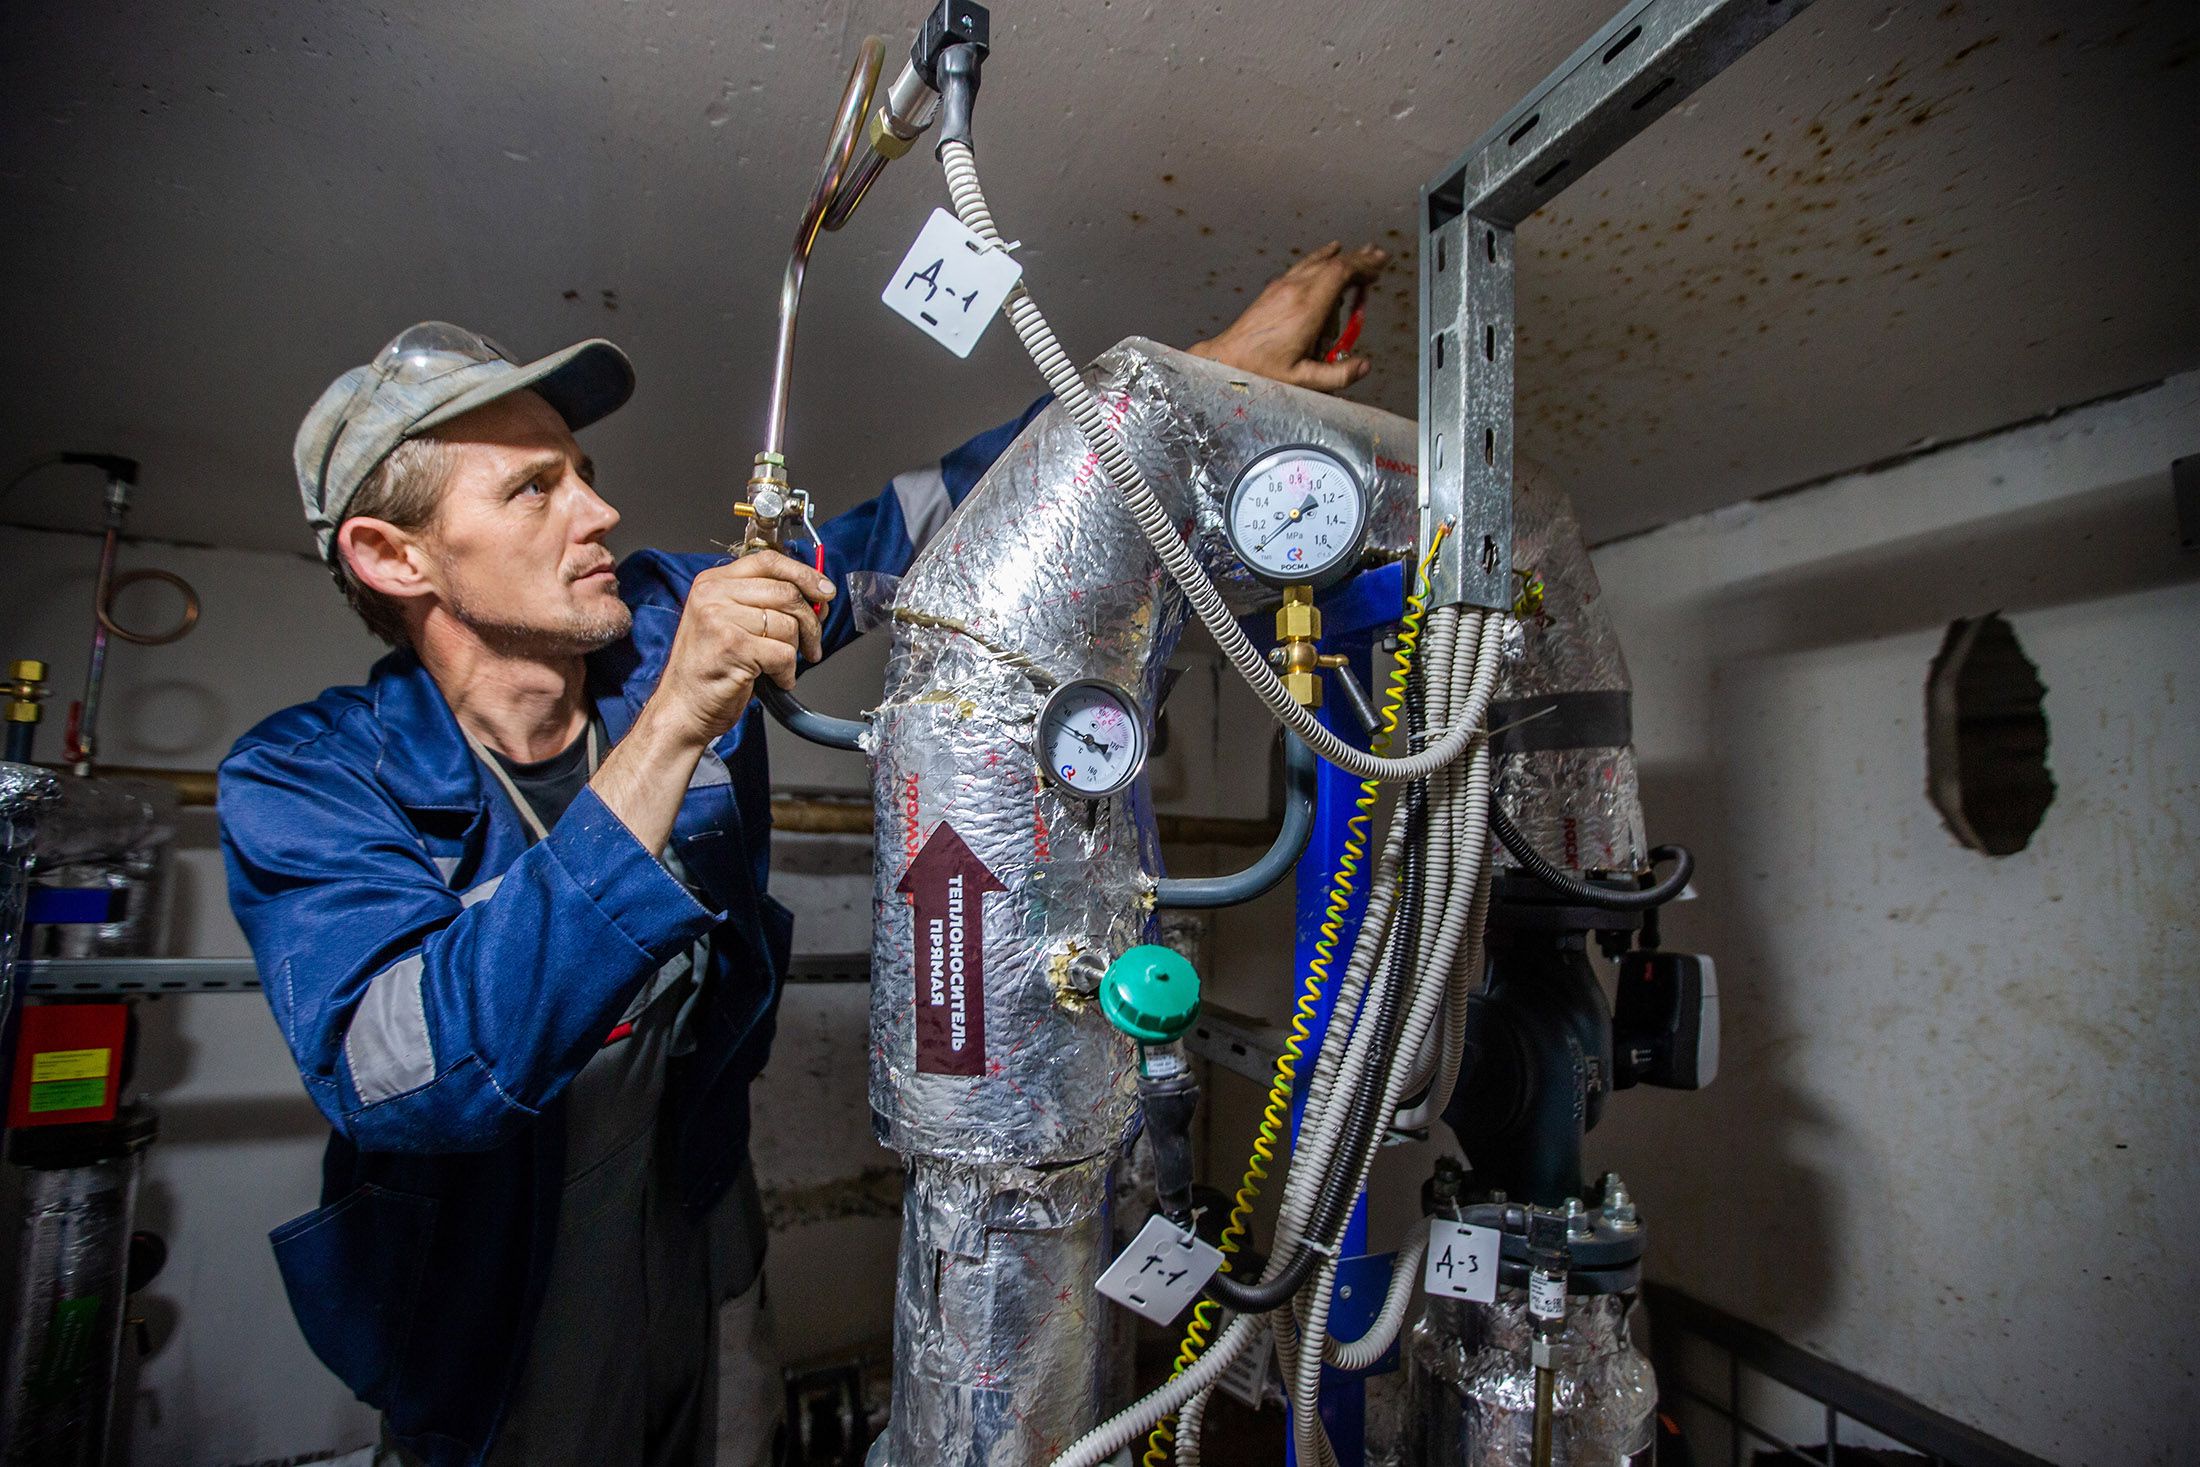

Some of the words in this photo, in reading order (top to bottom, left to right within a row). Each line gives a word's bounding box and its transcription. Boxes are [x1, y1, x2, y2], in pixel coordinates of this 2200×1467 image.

[904, 258, 979, 313] Д-1
[1269, 482, 1283, 493] 0,6
[1256, 496, 1269, 508] 0,4
[1323, 493, 1335, 504] 1,2
[1252, 520, 1266, 531] 0,2
[1326, 514, 1338, 526] 1,4
[1315, 534, 1327, 546] 1,6
[930, 918, 944, 1006] ПРЯМАЯ
[948, 874, 965, 1051] ТЕПЛОНОСИТЕЛЬ
[1436, 1244, 1479, 1279] Д-3
